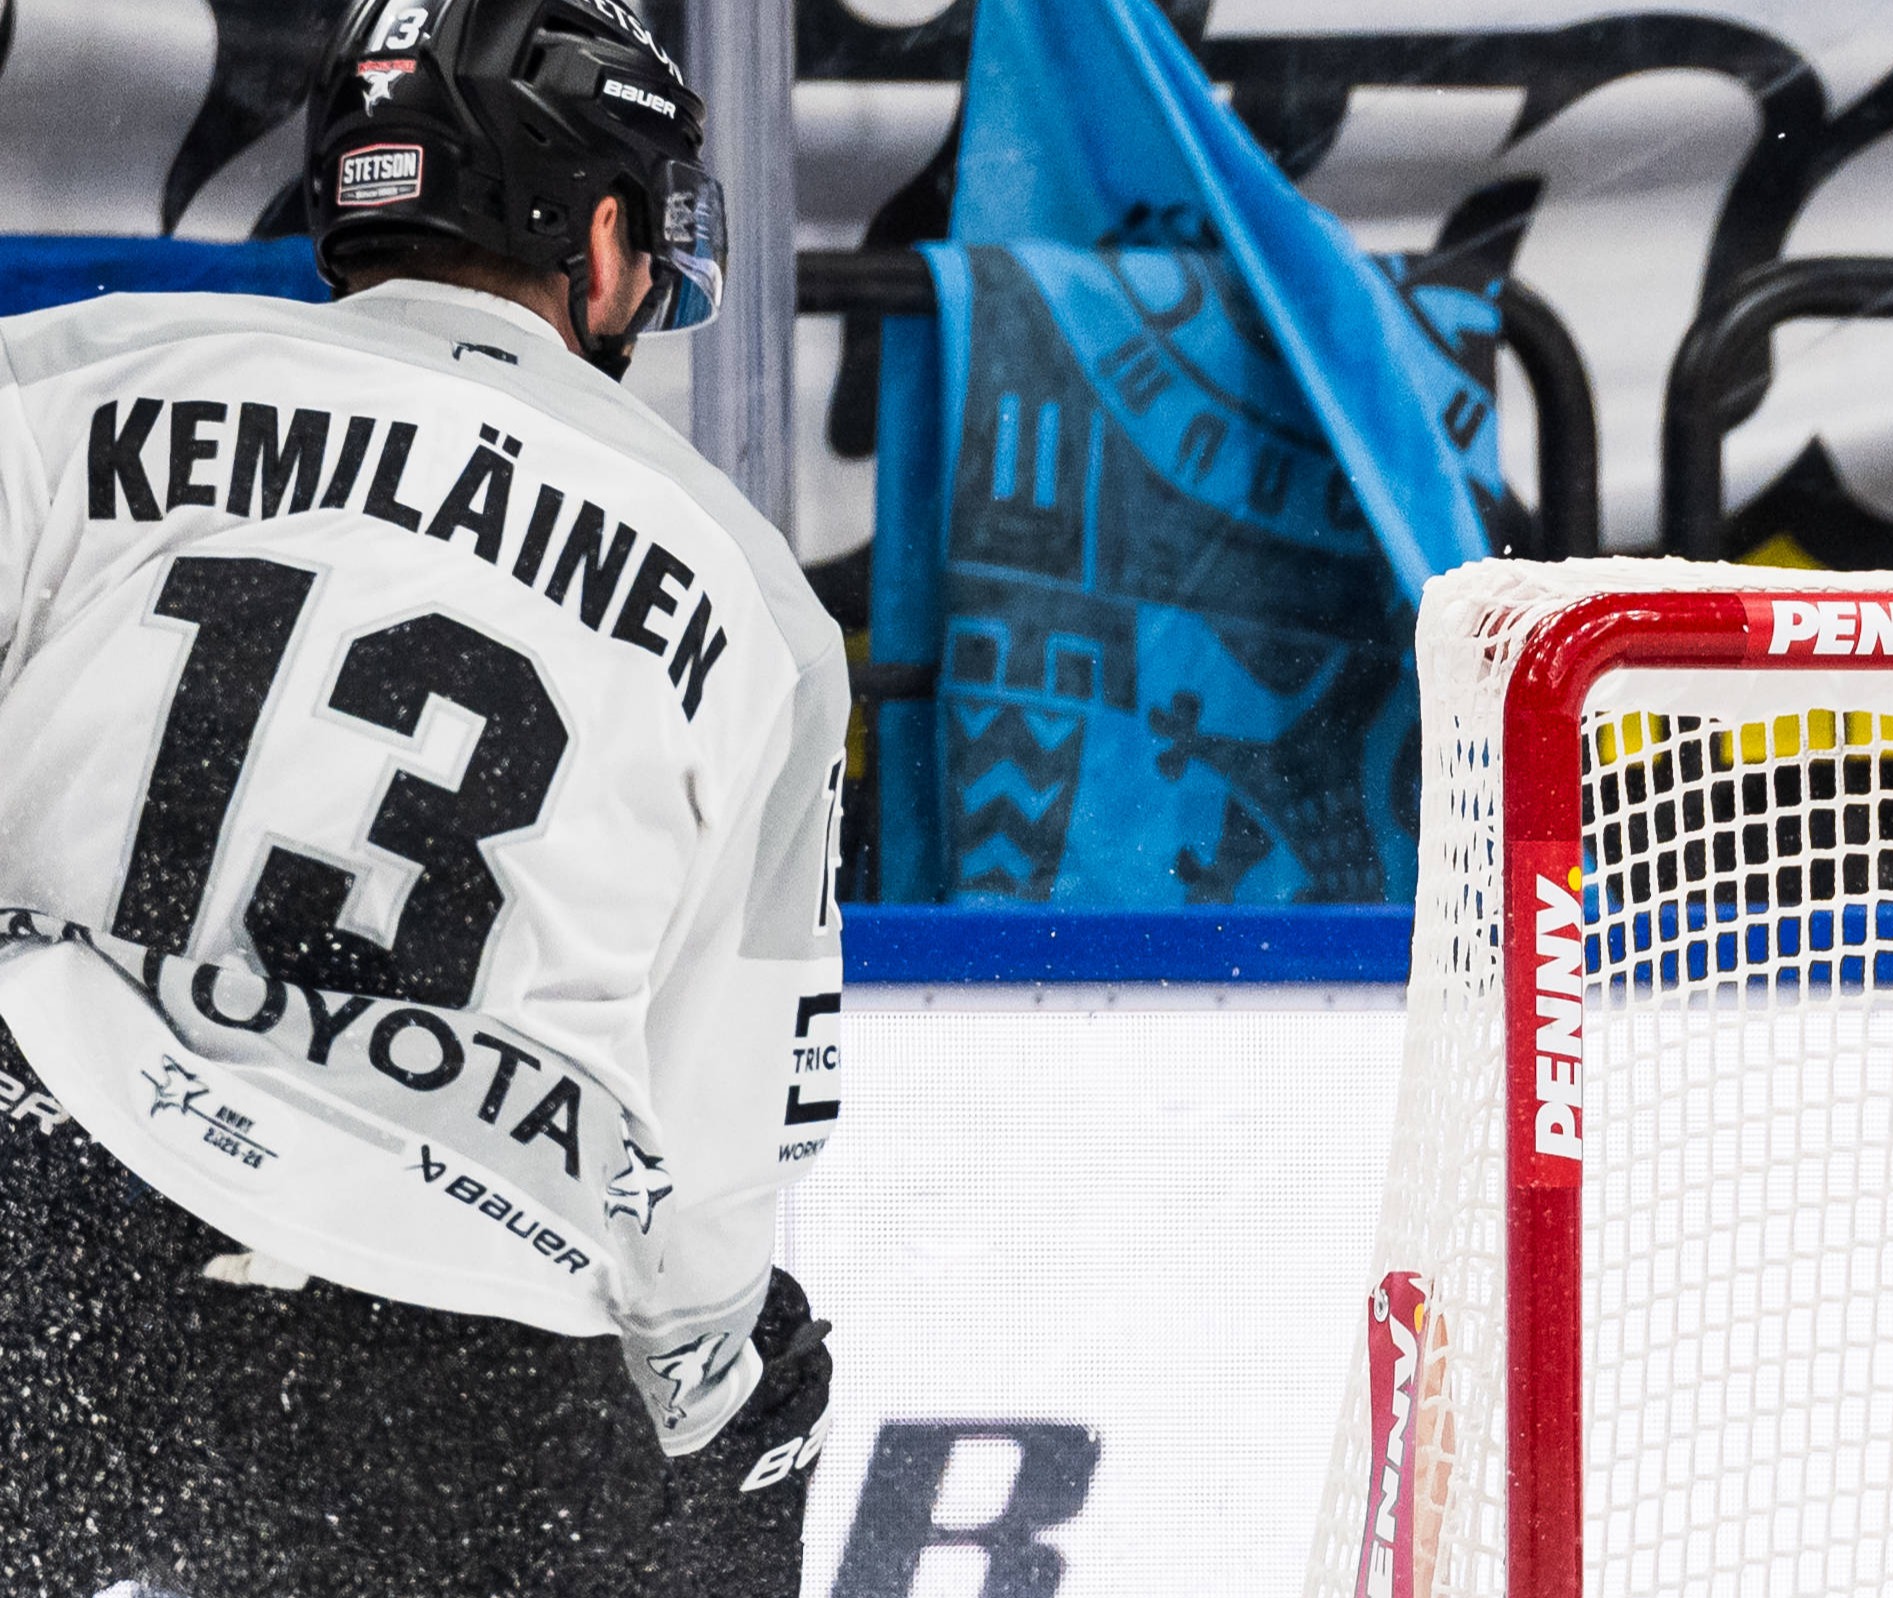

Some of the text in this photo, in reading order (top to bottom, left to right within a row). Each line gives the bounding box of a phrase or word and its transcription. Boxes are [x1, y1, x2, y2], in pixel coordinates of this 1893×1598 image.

[343, 152, 417, 185] STETSON
[86, 396, 729, 723] KEMILÄINEN
[106, 552, 572, 1008] 13
[793, 1045, 841, 1074] TRIC
